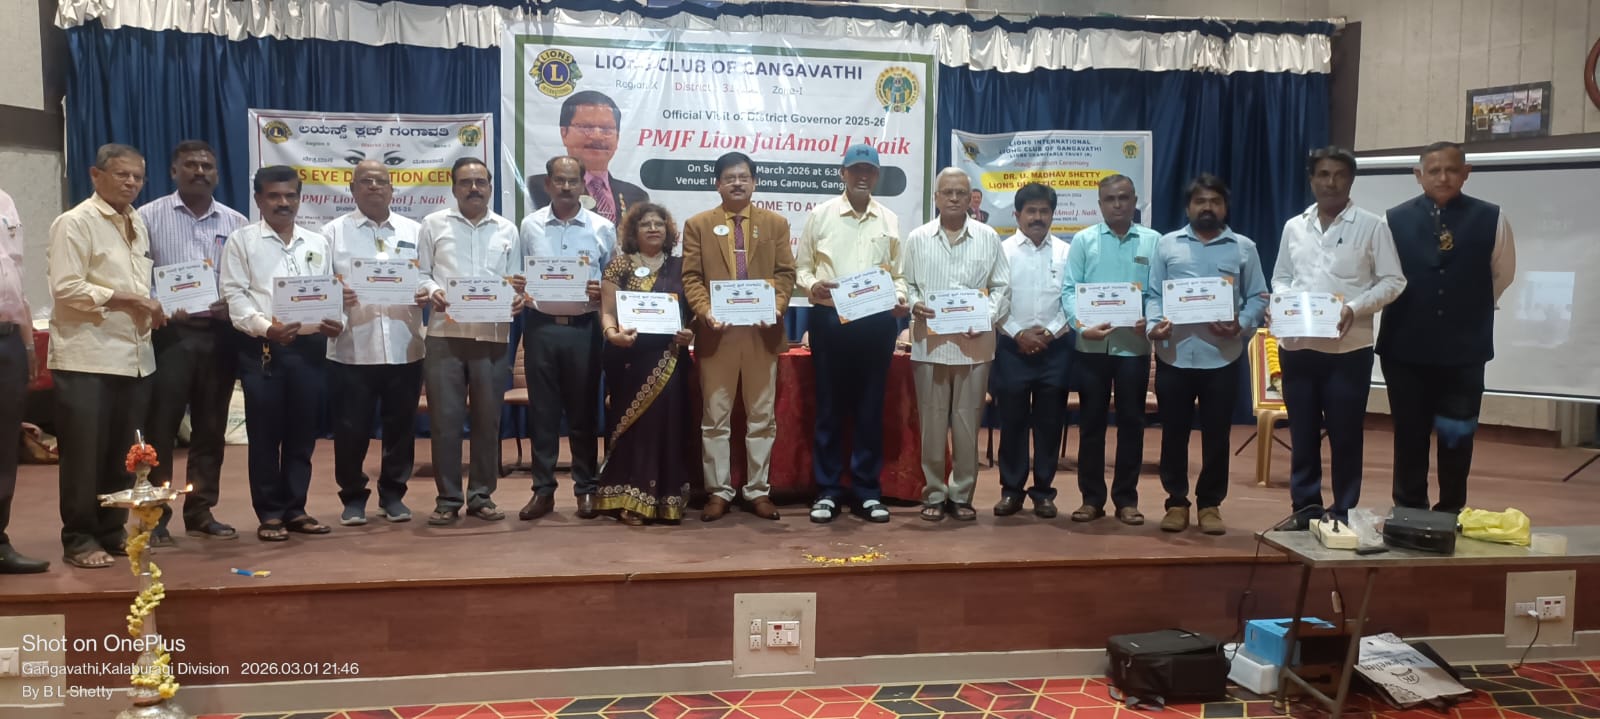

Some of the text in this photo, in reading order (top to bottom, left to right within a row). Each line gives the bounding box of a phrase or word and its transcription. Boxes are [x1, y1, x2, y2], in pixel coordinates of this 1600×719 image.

[540, 50, 571, 62] LIONS
[658, 57, 706, 73] CLUB
[710, 60, 737, 75] OF
[550, 64, 564, 81] L
[662, 109, 702, 120] Official
[790, 113, 842, 126] Governor
[845, 116, 885, 127] 2025-26
[637, 128, 695, 152] PMJF
[699, 130, 747, 149] Lion
[750, 131, 838, 154] JaiAmol
[312, 169, 338, 183] EYE
[687, 164, 701, 173] On
[756, 165, 785, 175] March
[787, 167, 810, 176] 2026
[812, 168, 822, 176] at
[1031, 171, 1066, 179] MADHAV
[1068, 170, 1101, 178] SHETTY
[675, 176, 708, 186] Venue:
[780, 179, 819, 189] Campus,
[988, 181, 1014, 190] LIONS
[1058, 179, 1082, 188] CARE
[302, 193, 330, 205] PMJF
[420, 195, 446, 205] Naik
[786, 201, 802, 212] TO
